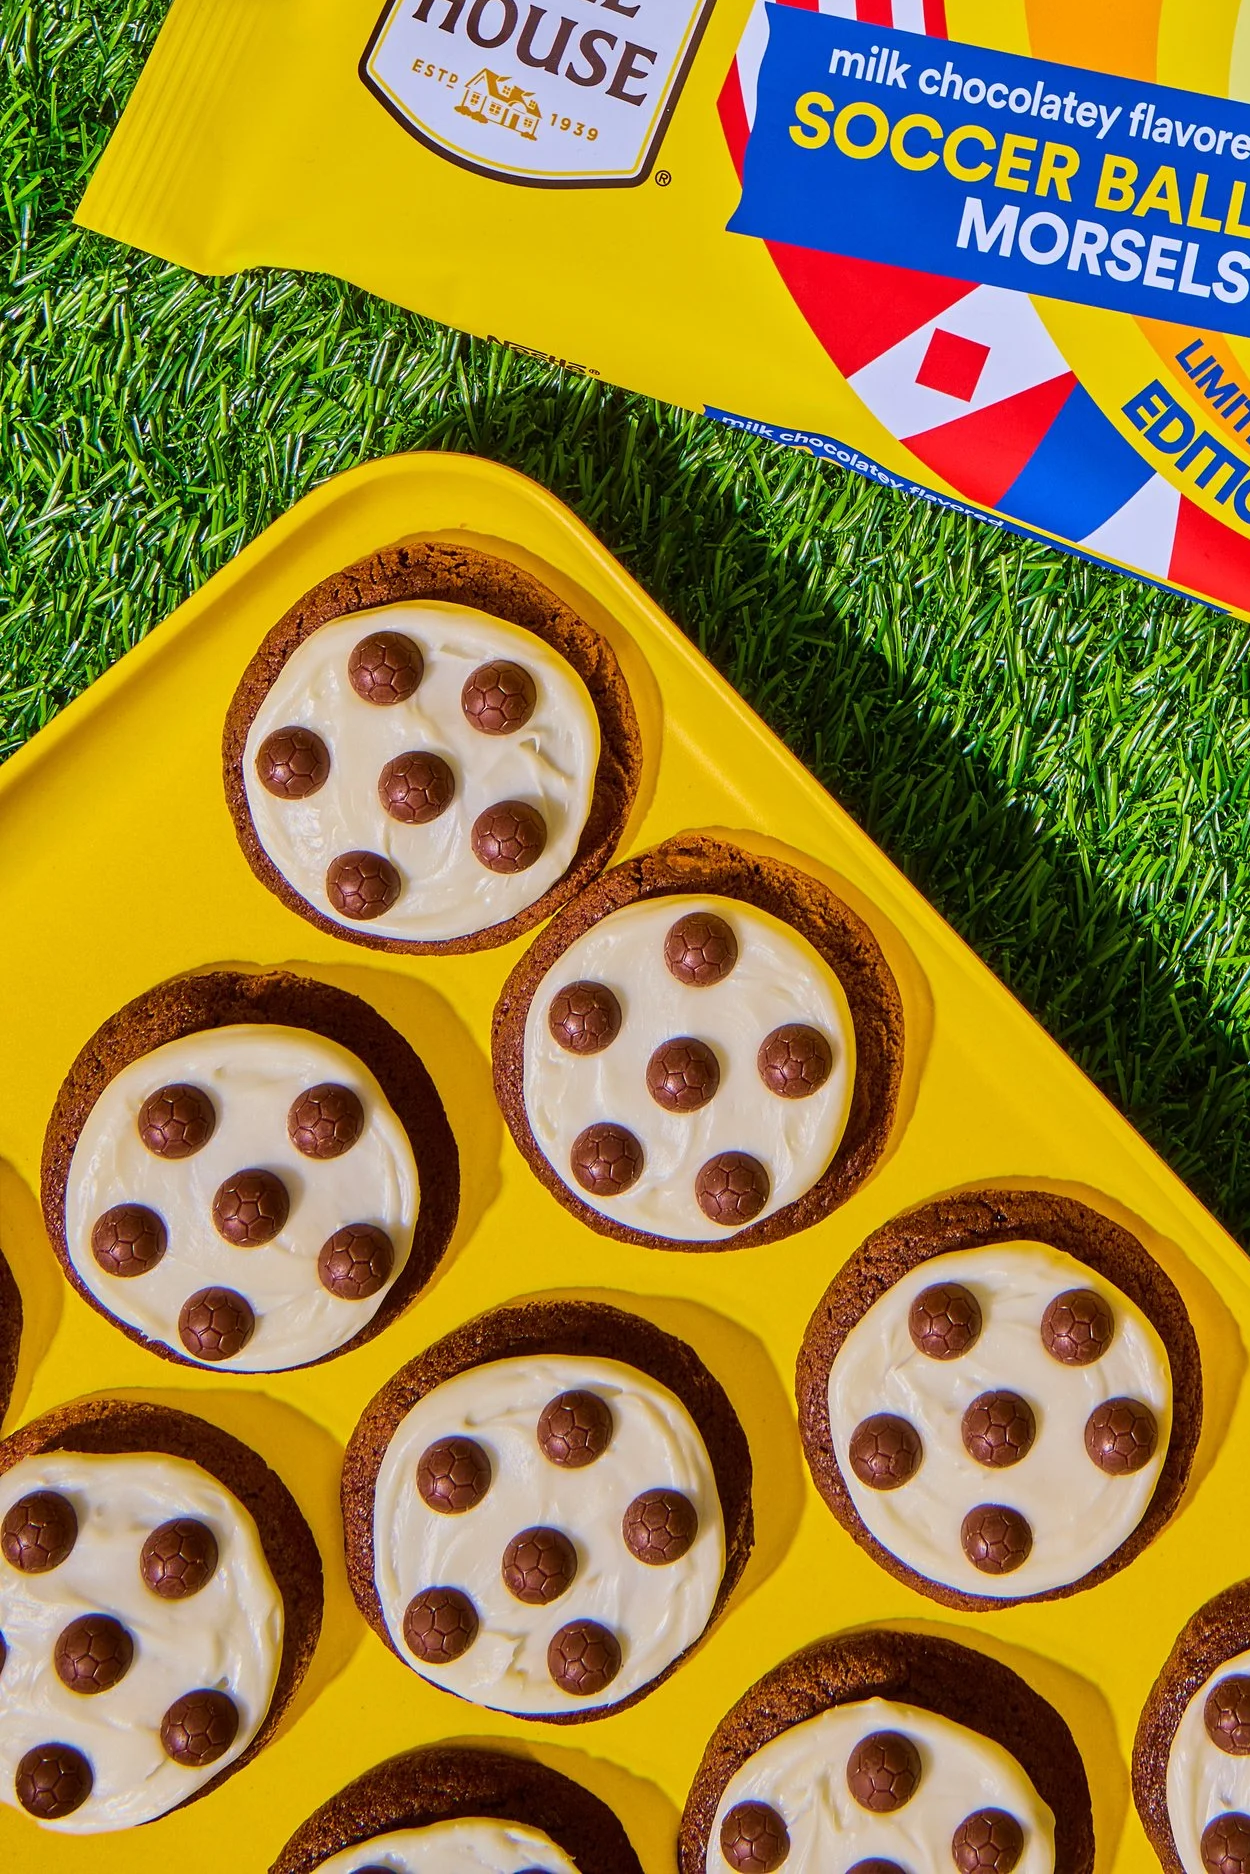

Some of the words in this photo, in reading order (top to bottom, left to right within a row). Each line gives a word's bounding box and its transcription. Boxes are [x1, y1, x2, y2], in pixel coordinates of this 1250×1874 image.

[550, 113, 599, 142] 1939
[828, 46, 912, 89] milk
[918, 61, 1123, 140] chocolatey
[788, 91, 1081, 202] SOCCER
[721, 416, 774, 437] milk
[780, 429, 904, 489] chocolatey
[909, 486, 1004, 527] flavored
